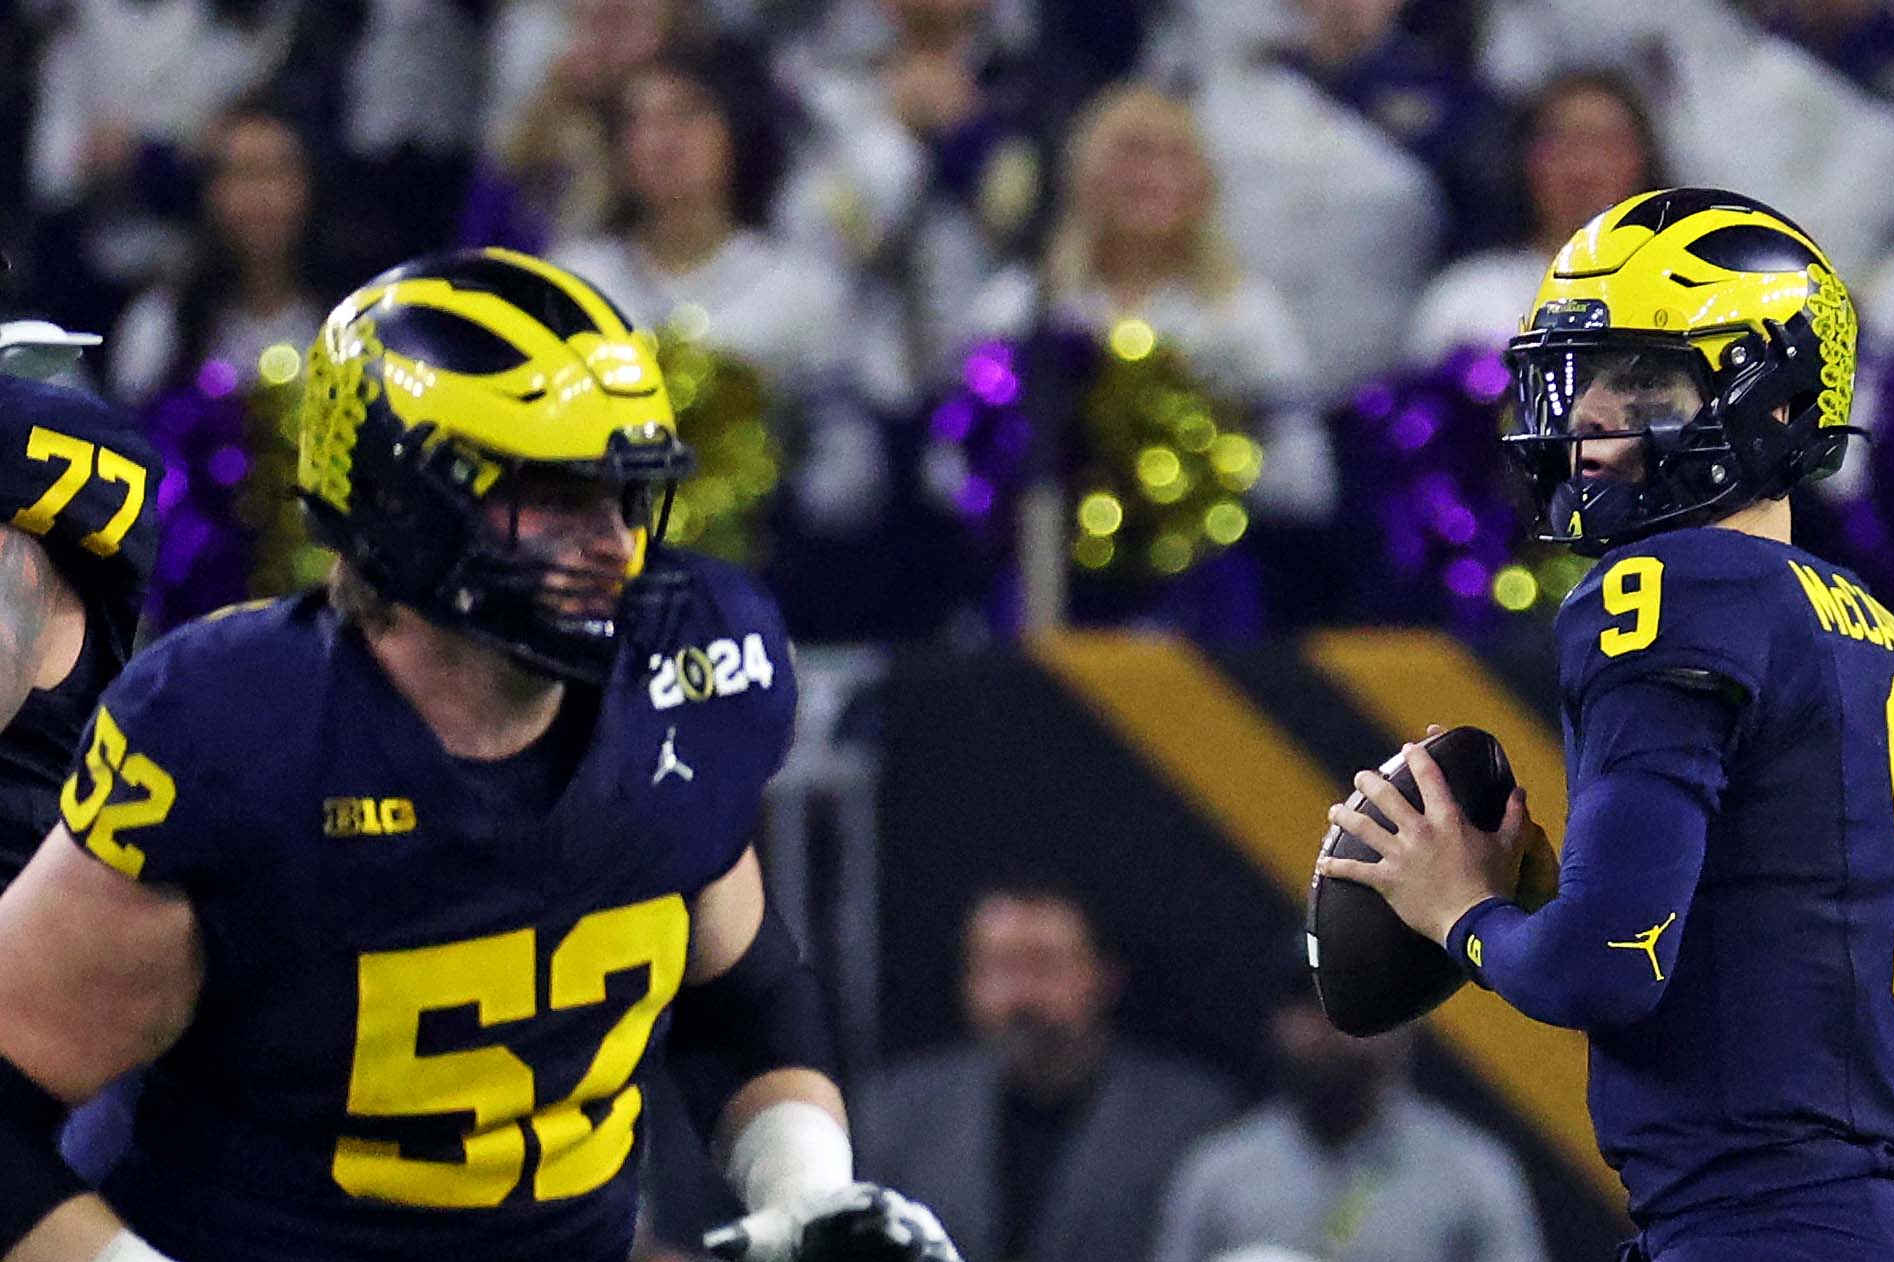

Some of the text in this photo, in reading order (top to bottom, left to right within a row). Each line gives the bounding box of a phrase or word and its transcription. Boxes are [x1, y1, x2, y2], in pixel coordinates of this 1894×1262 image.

[12, 425, 147, 557] 77
[648, 632, 774, 710] 2024
[1600, 556, 1664, 657] 9
[60, 704, 176, 880] 52
[331, 892, 690, 1208] 52
